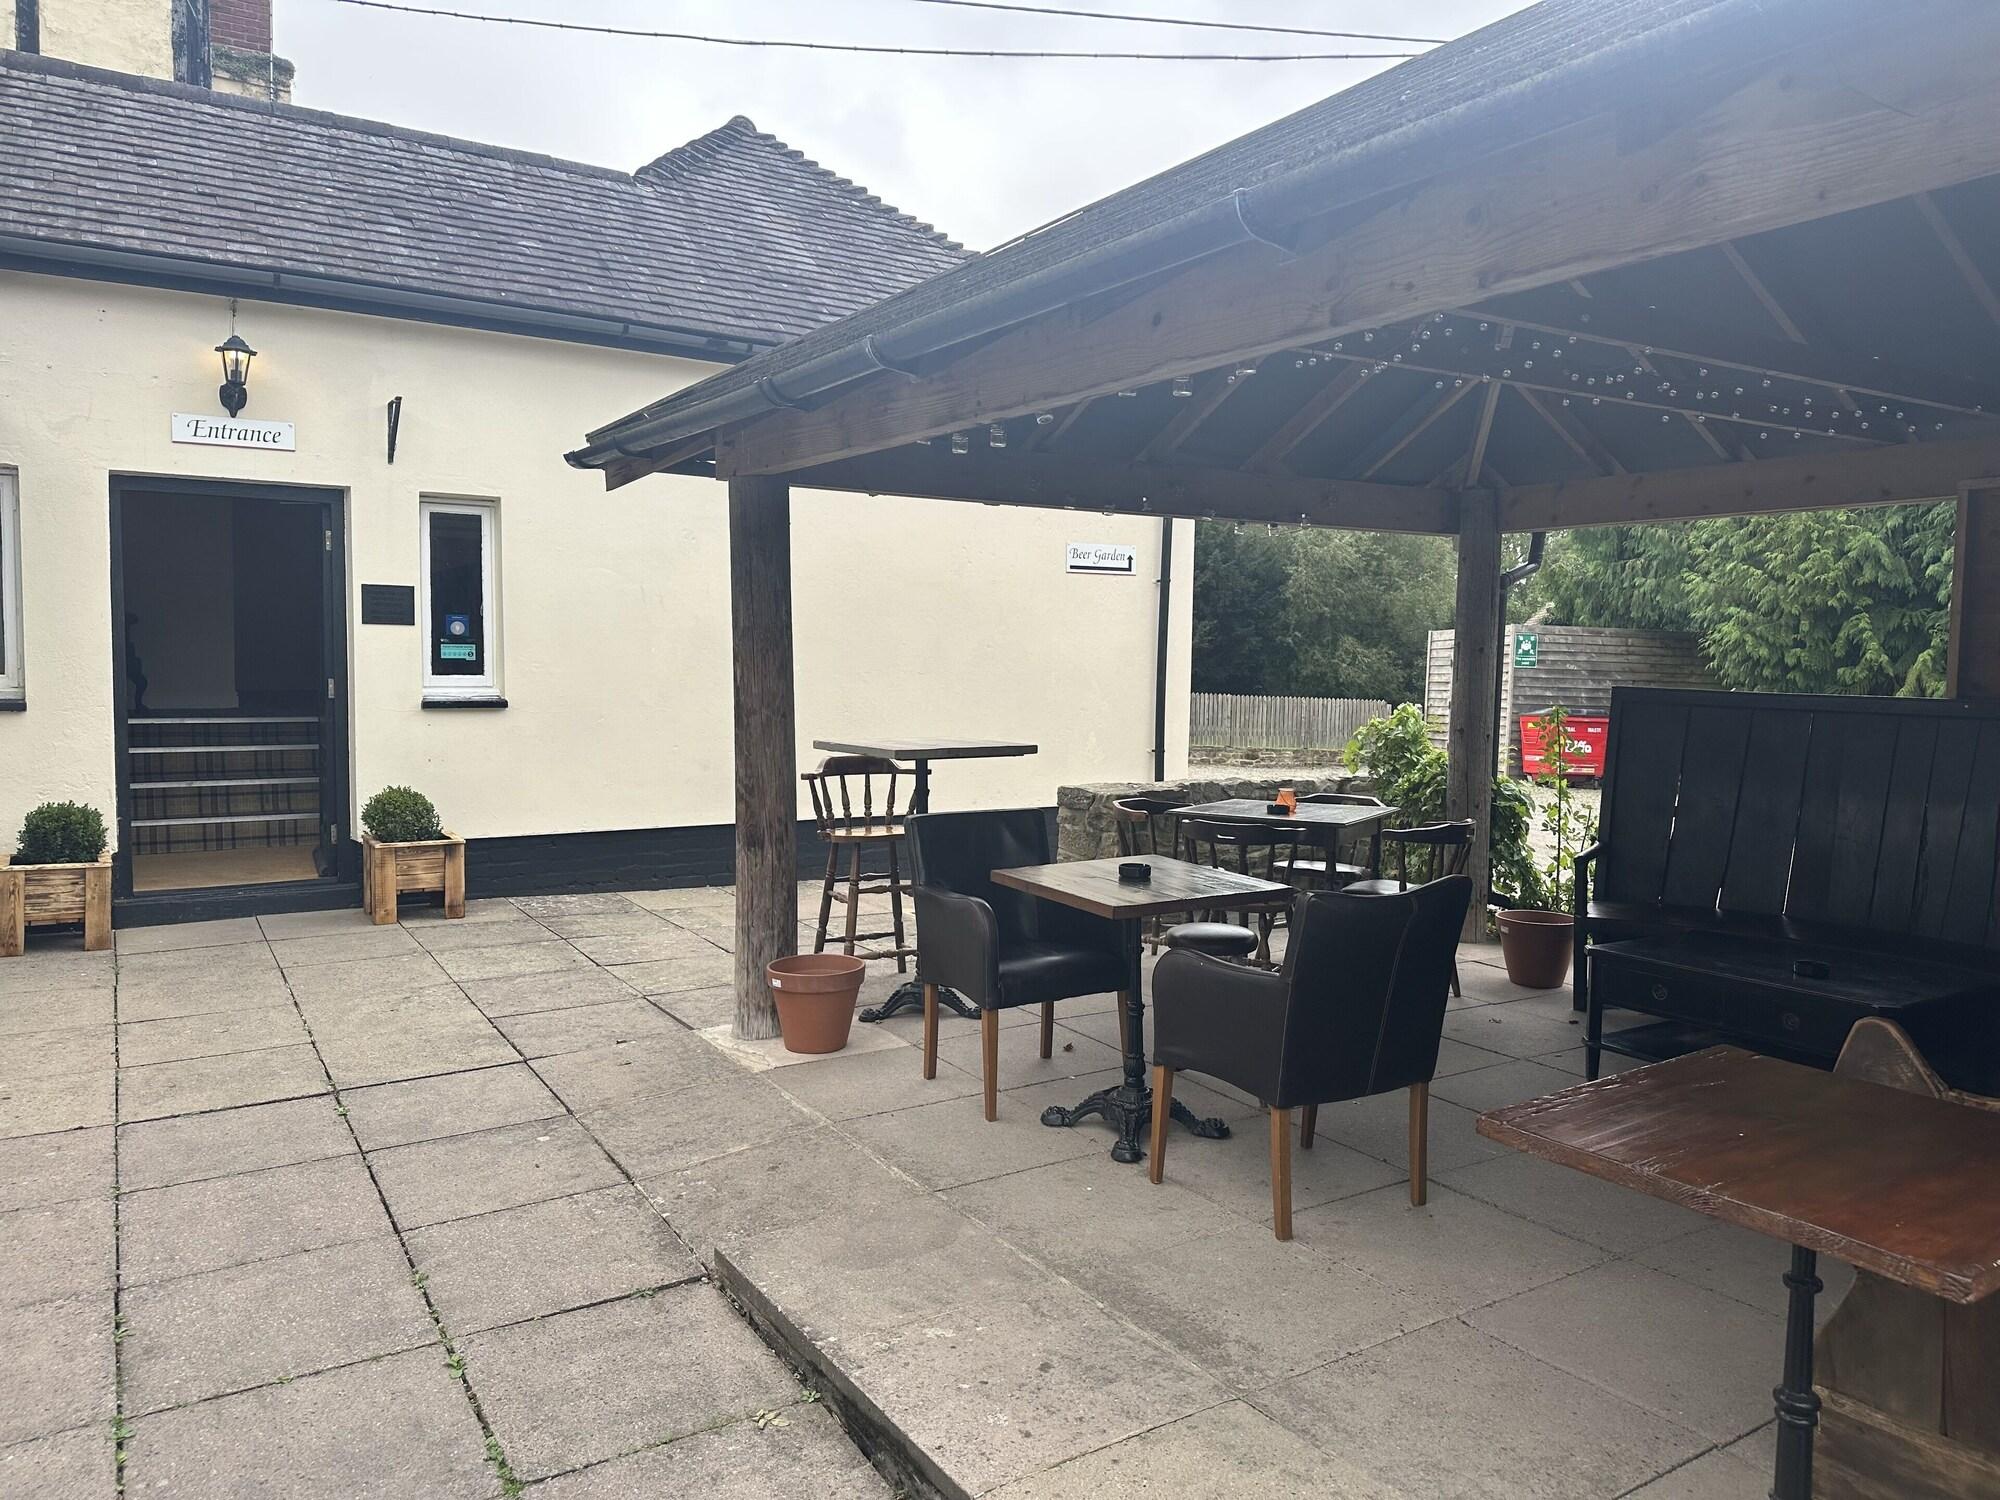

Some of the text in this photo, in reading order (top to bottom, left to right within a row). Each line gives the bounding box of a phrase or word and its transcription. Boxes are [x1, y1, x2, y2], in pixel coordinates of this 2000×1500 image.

[187, 419, 281, 443] Entrance
[1069, 547, 1126, 564] Beer Garden
